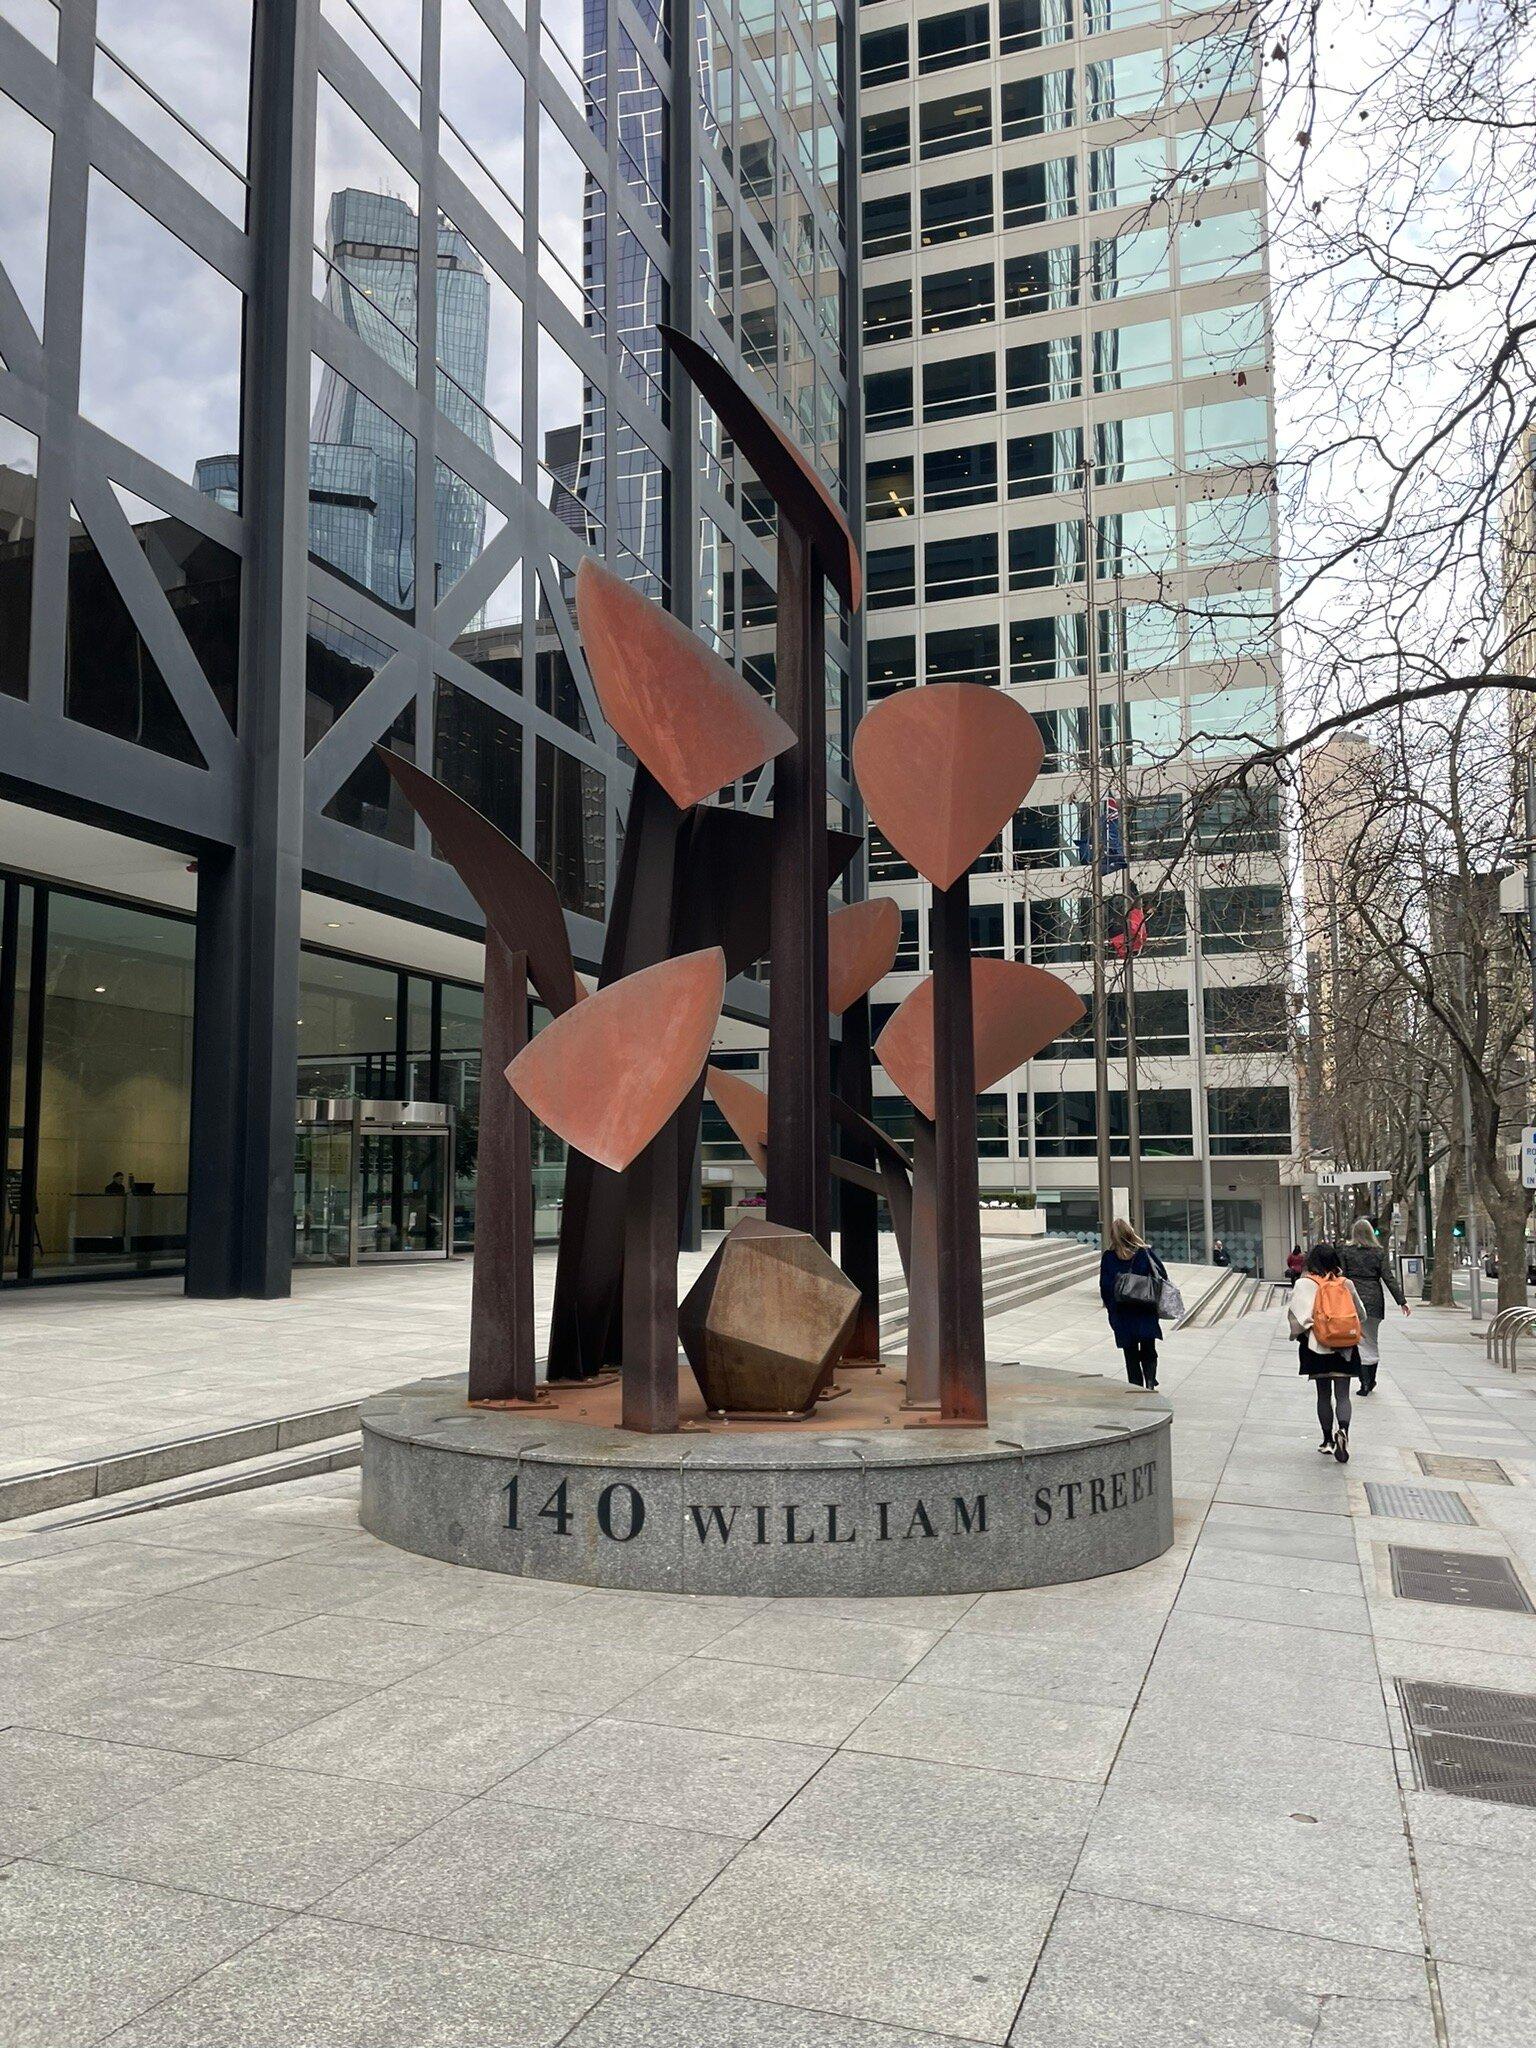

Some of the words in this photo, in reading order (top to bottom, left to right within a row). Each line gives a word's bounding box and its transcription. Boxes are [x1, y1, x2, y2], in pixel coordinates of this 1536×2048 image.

[502, 1474, 646, 1542] 140
[686, 1494, 989, 1545] WILLIAM
[1033, 1460, 1157, 1527] STREET
